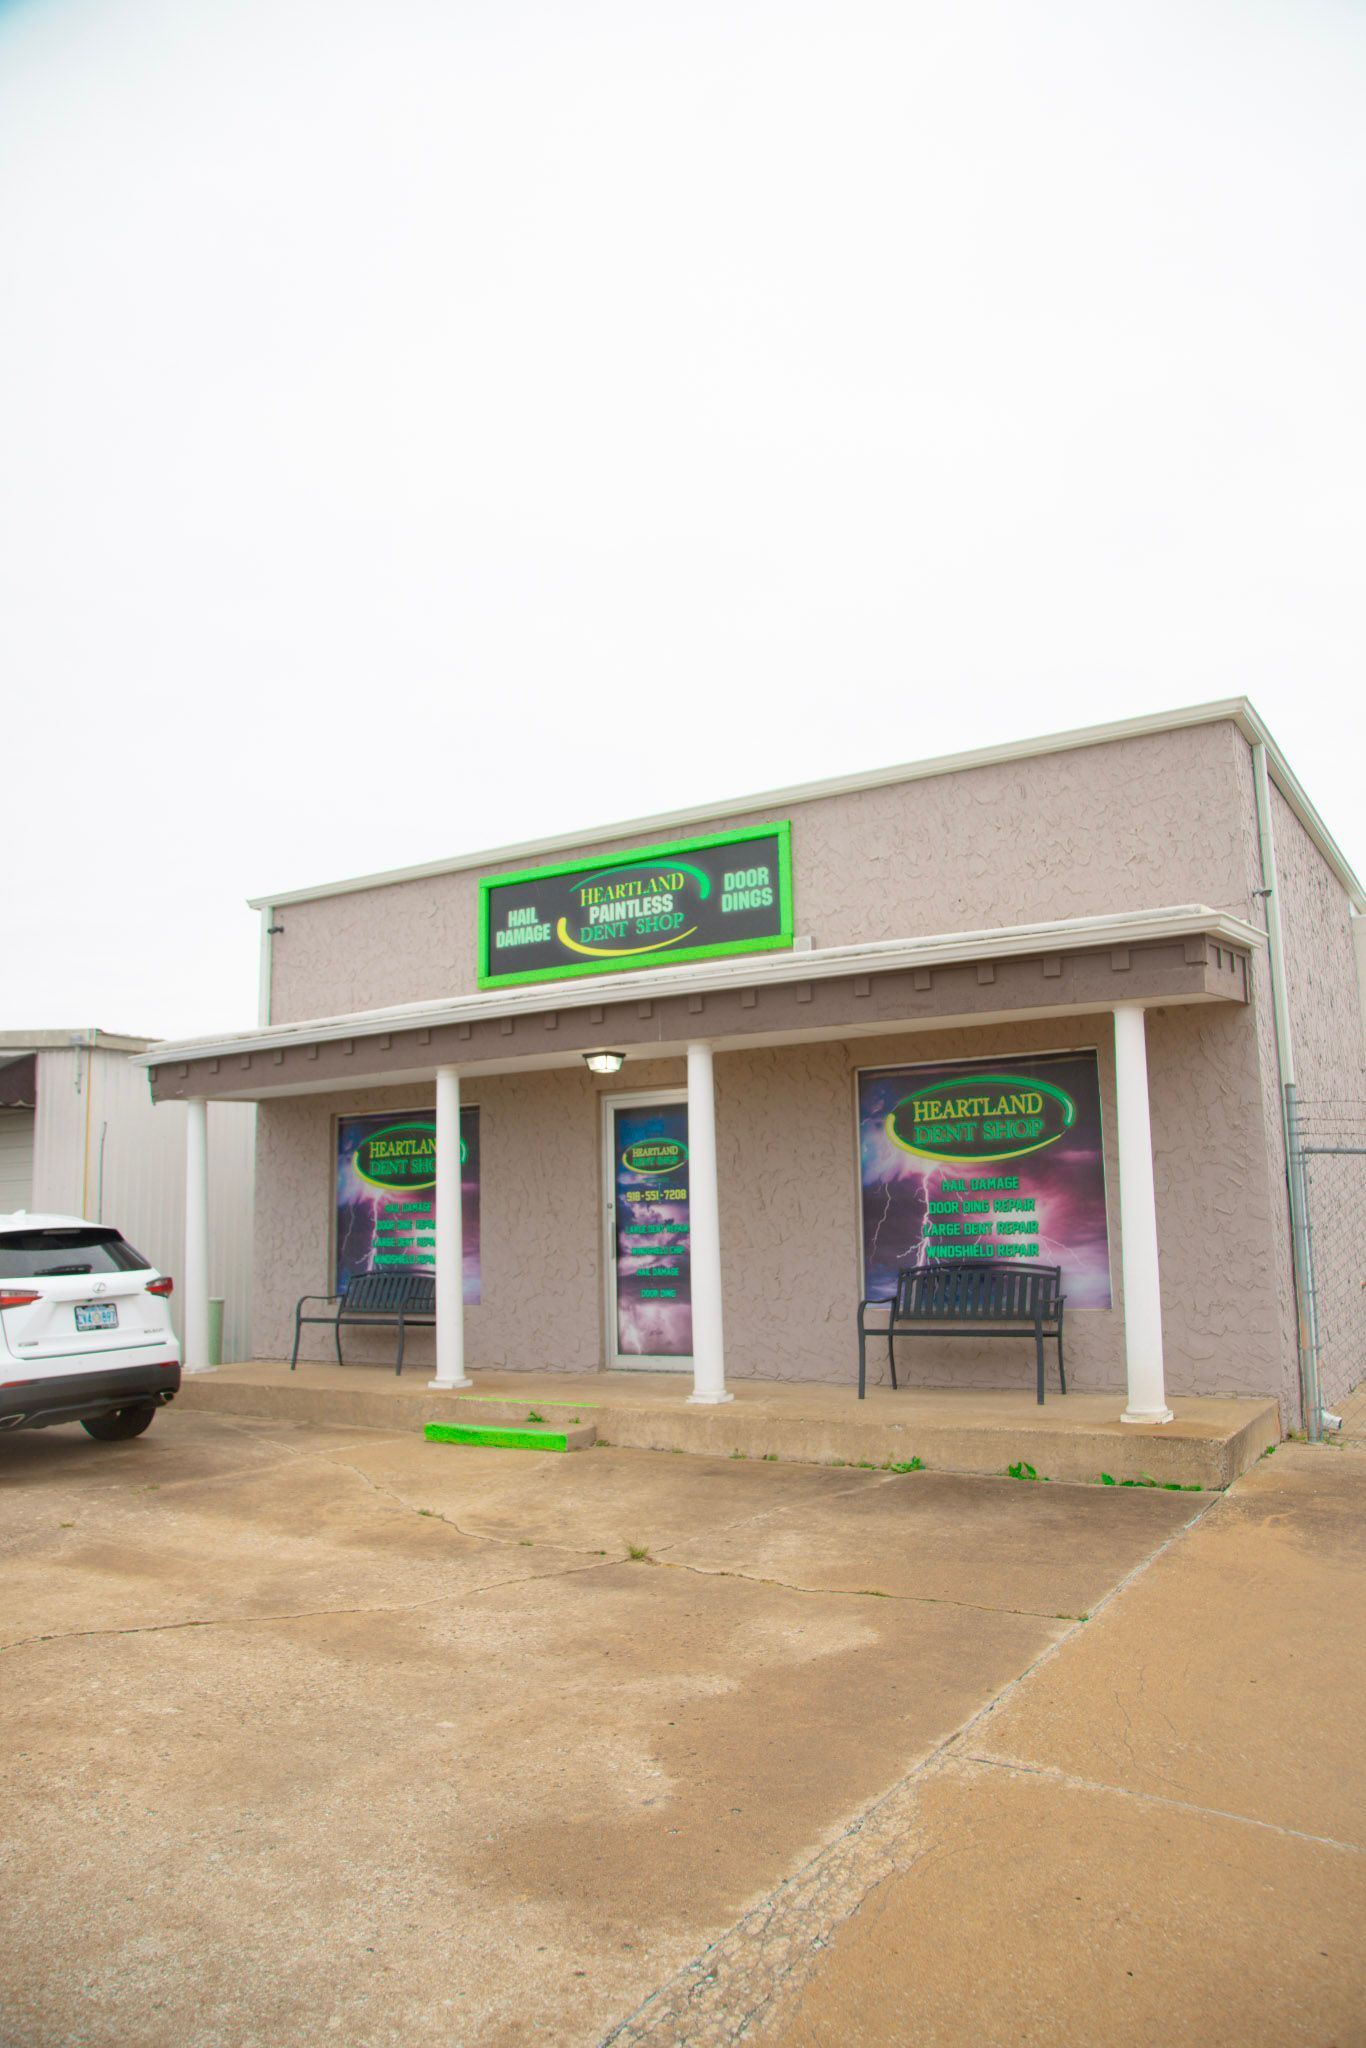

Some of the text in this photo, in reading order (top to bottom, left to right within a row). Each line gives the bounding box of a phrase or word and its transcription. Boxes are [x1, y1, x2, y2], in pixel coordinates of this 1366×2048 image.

[580, 872, 684, 907] HEARTLAND
[724, 867, 769, 891] DOOR
[589, 894, 673, 925] PAINTLESS
[721, 887, 773, 913] DINGS
[508, 907, 538, 928] HAIL
[580, 912, 685, 943] DENT SHOP
[496, 923, 551, 949] DAMAGE
[913, 1093, 1042, 1122] HEARTLAND
[914, 1119, 1043, 1145] DENT SHOP
[369, 1138, 436, 1159] HEARTLAN
[631, 1146, 679, 1157] HEARTLAND
[370, 1157, 436, 1176] DENT SHO
[942, 1176, 1019, 1192] HAIL DAMAGE
[929, 1198, 1035, 1214] DOOR DING REPAIR
[923, 1221, 1039, 1237] LARGE DENT REPAIR
[925, 1243, 1039, 1258] WINDSHIELD REPAIR
